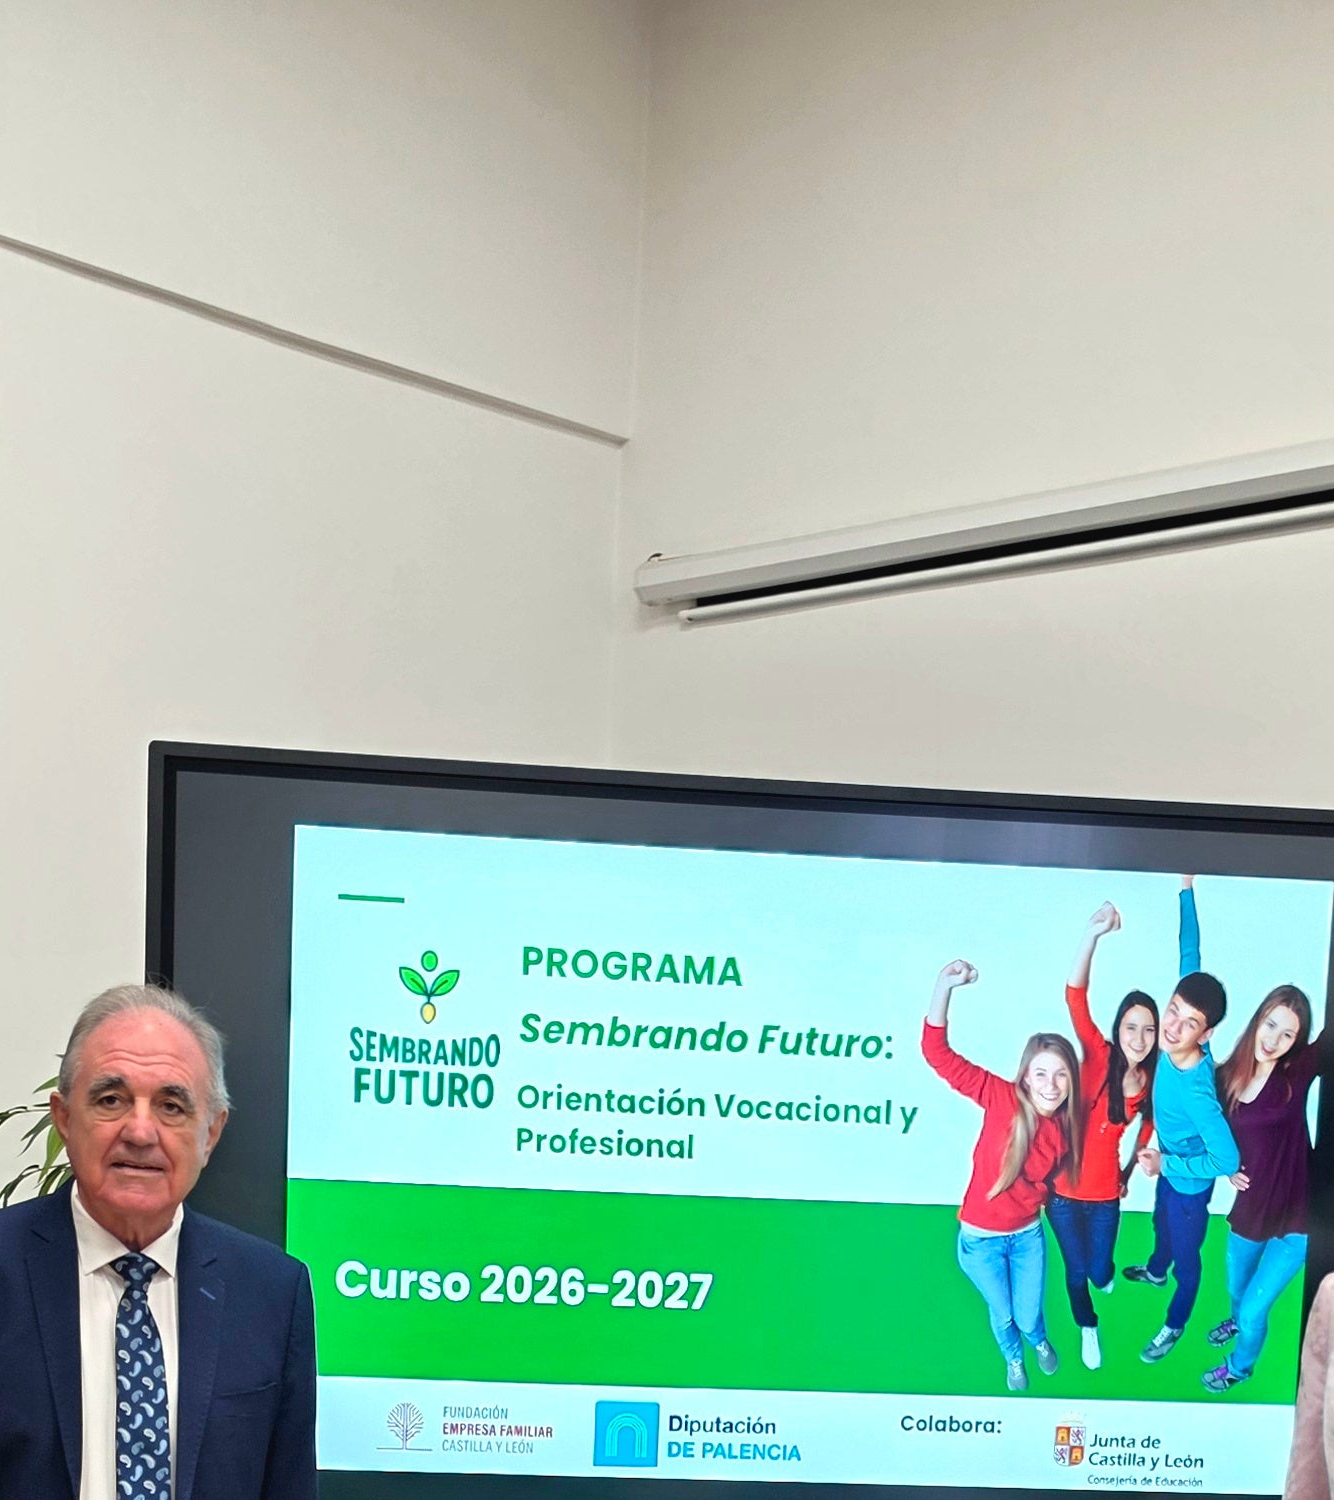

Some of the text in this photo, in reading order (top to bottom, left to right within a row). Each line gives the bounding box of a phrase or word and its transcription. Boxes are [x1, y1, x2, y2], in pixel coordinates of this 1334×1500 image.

[522, 946, 743, 987] PROGRAMA
[349, 1026, 500, 1068] SEMBRANDO
[520, 1014, 894, 1059] Sembrando Futuro:
[353, 1068, 494, 1109] FUTURO
[517, 1083, 918, 1134] Orientación Vocacional y
[516, 1128, 694, 1159] Profesional
[335, 1260, 714, 1310] Curso 2026-2027
[443, 1405, 508, 1419] FUNDACIÓN
[442, 1422, 553, 1438] EMPRESA FAMILIAR
[668, 1414, 776, 1436] Diputación
[900, 1414, 1002, 1434] Colabora:
[442, 1439, 534, 1454] CASTILLA Y LEÓN
[667, 1441, 802, 1461] DE PALENCIA
[1089, 1434, 1161, 1449] Junta de
[1088, 1452, 1204, 1471] Castilla y León
[1087, 1474, 1203, 1487] Consejería de Educación
